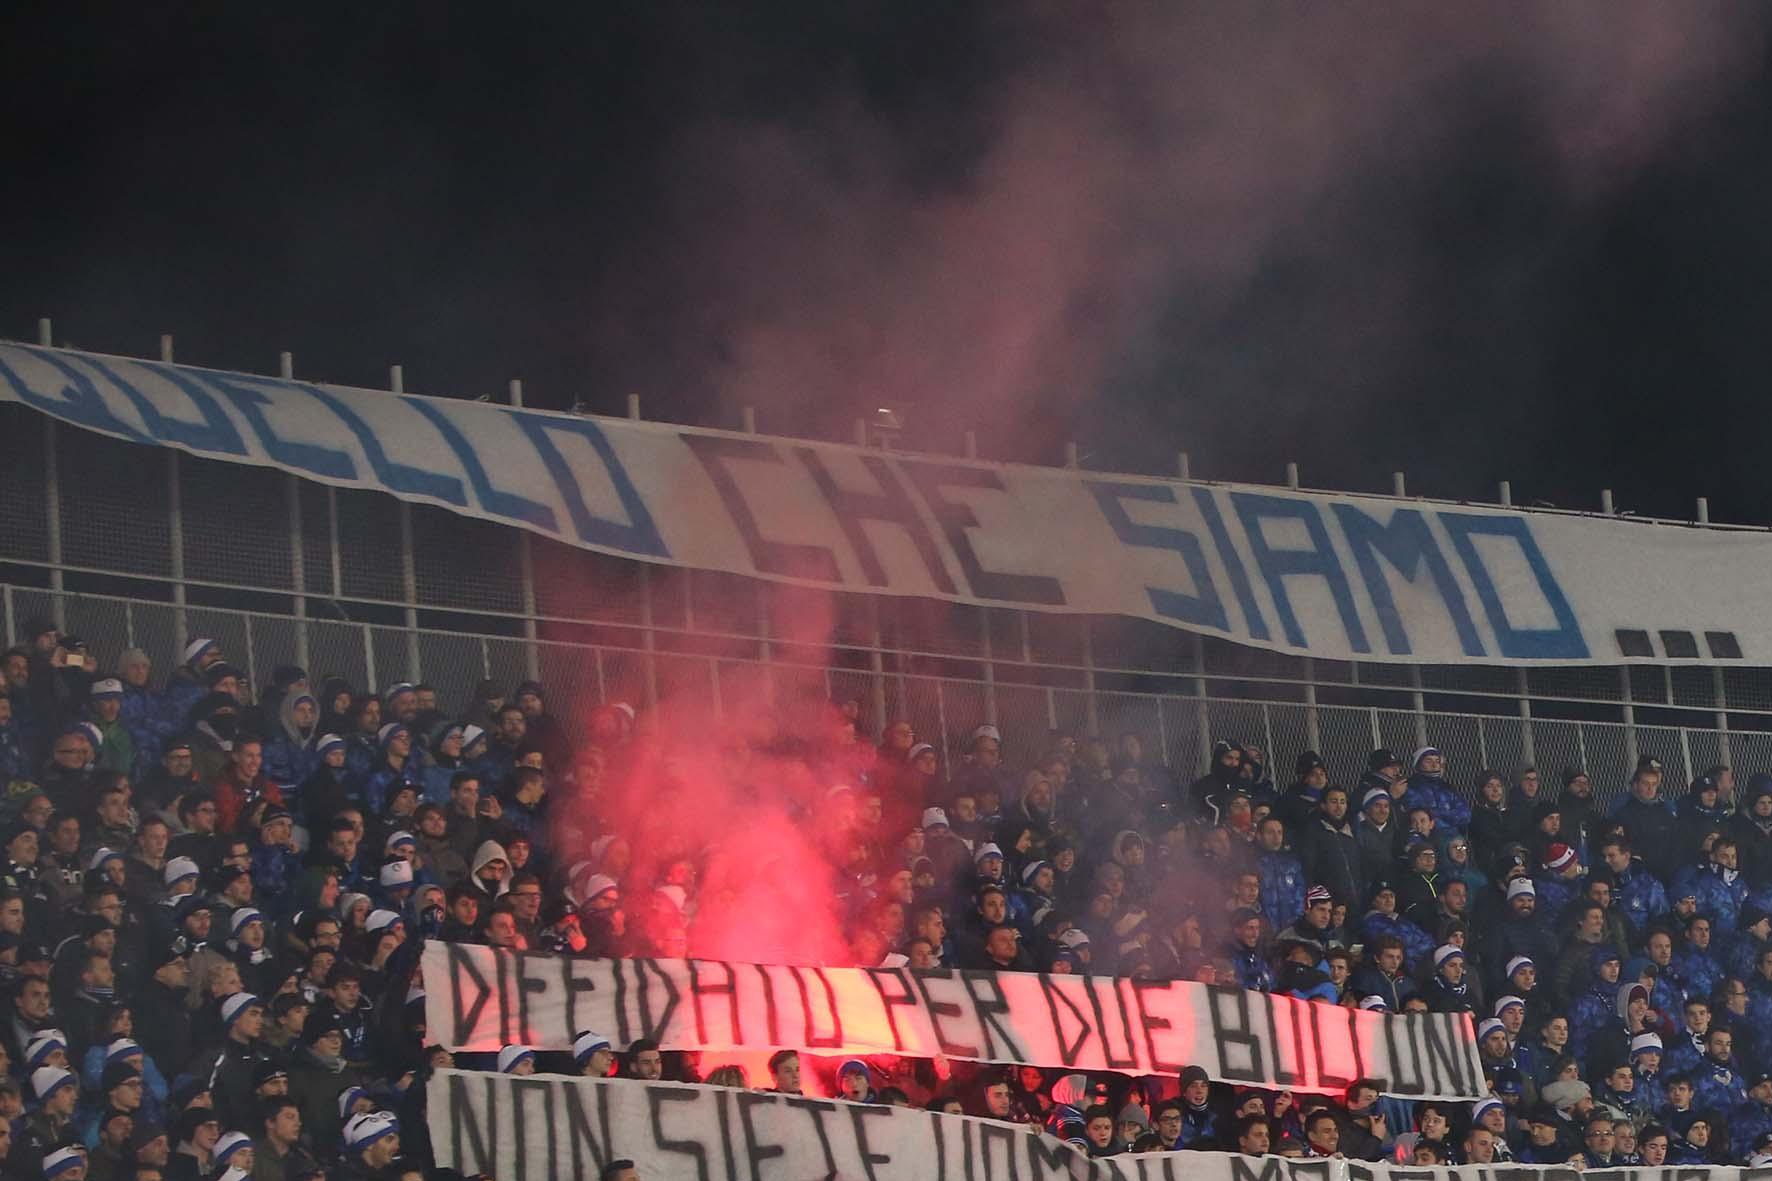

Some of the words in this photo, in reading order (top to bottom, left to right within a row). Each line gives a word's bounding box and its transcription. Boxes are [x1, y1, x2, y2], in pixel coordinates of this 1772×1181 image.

[680, 433, 1065, 604] CHE
[862, 967, 1025, 1063] PER
[1039, 973, 1186, 1073] DUE
